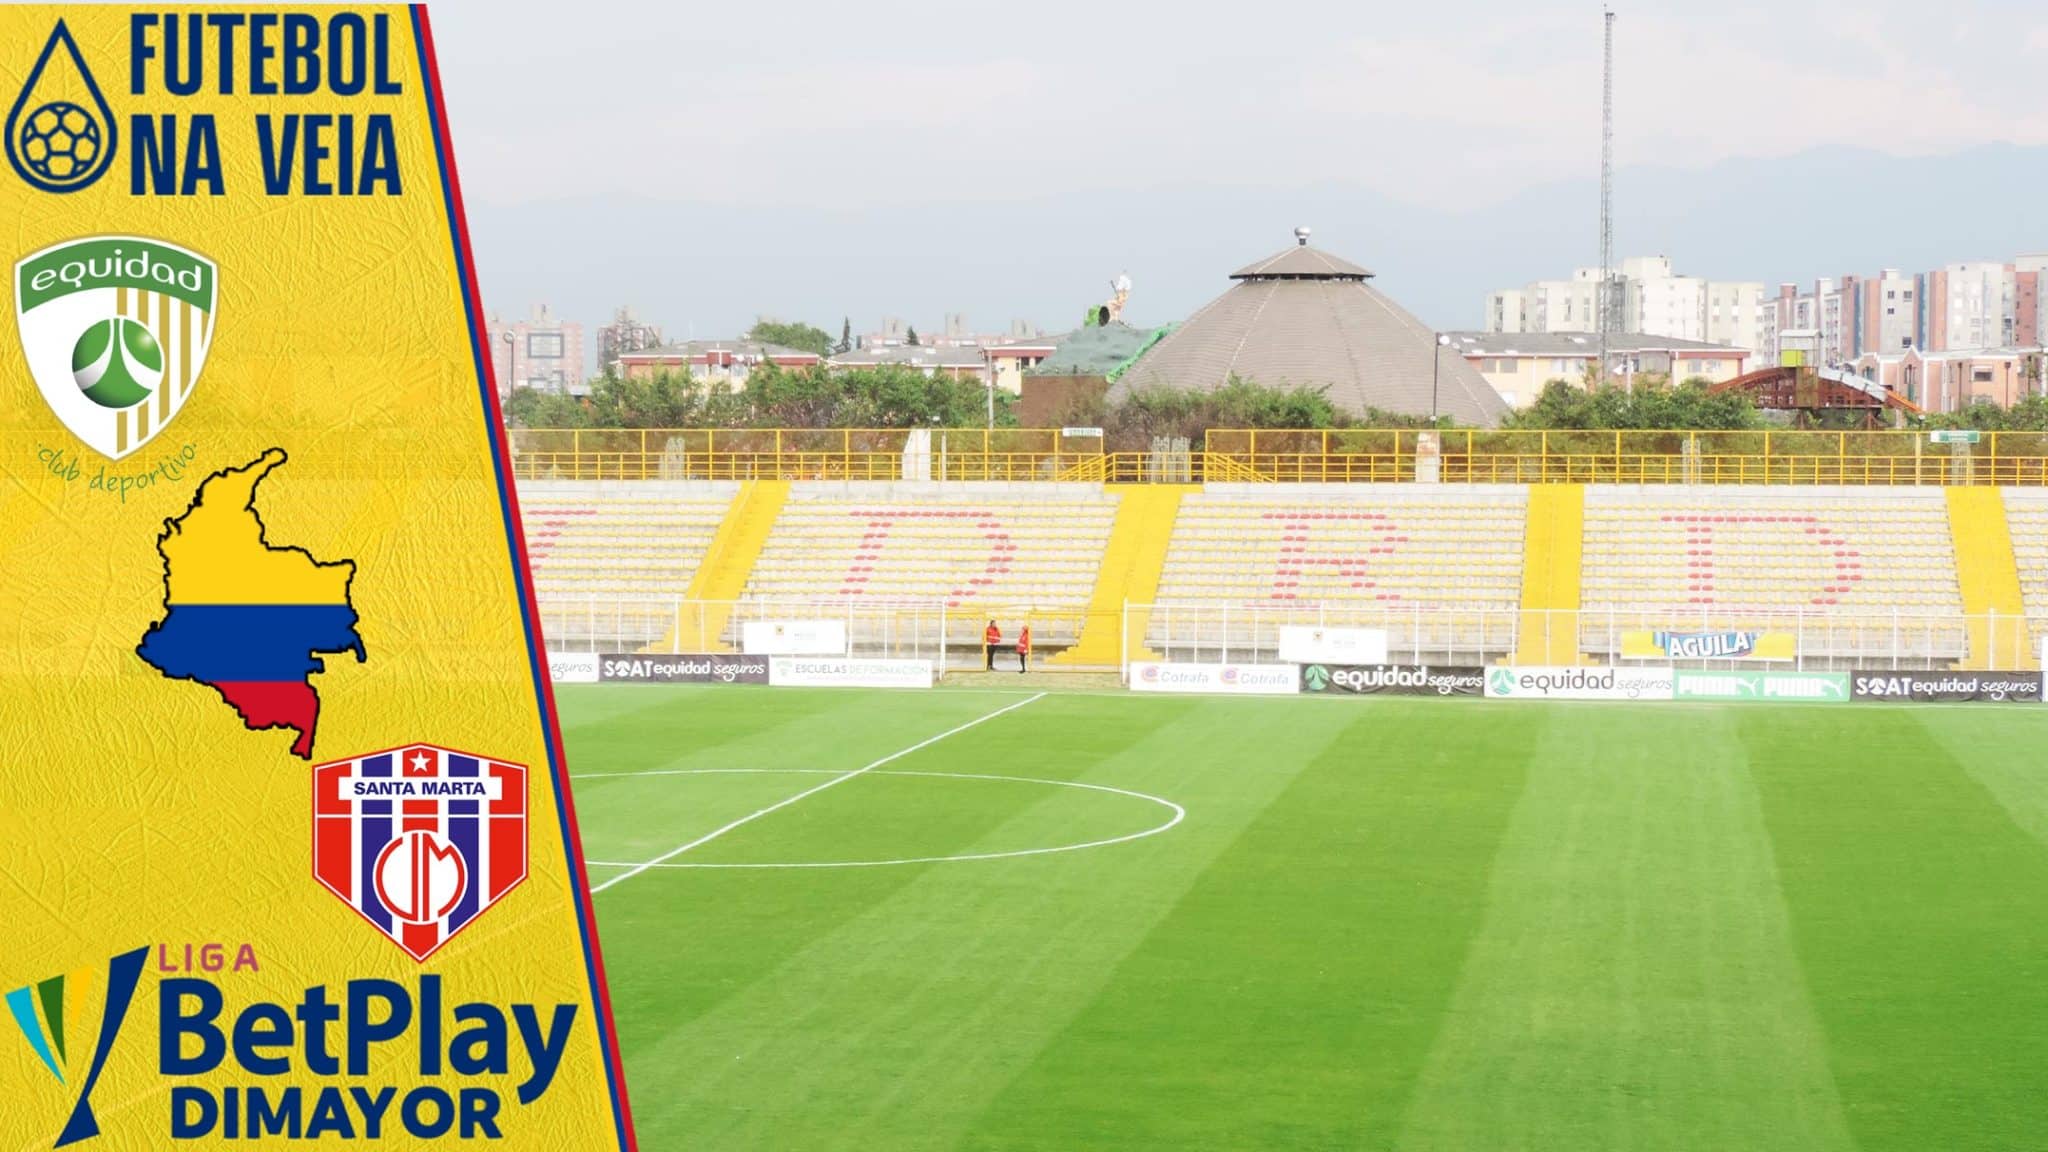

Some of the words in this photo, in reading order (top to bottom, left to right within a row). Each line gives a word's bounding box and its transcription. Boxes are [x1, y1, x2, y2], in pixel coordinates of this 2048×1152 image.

[1669, 632, 1750, 657] AGUILA
[551, 662, 593, 680] eguros
[653, 661, 711, 680] equidad
[713, 662, 766, 682] seguros
[795, 664, 848, 674] ESCUELAS
[1161, 671, 1209, 685] Cotrafa
[1240, 673, 1289, 686] Cotrafa
[1332, 665, 1427, 691] equidad
[1427, 675, 1484, 695] seguros
[1520, 669, 1615, 694] equidad
[1616, 680, 1673, 698] seguros
[1912, 678, 1977, 695] equidad
[1980, 681, 2038, 700] seguros
